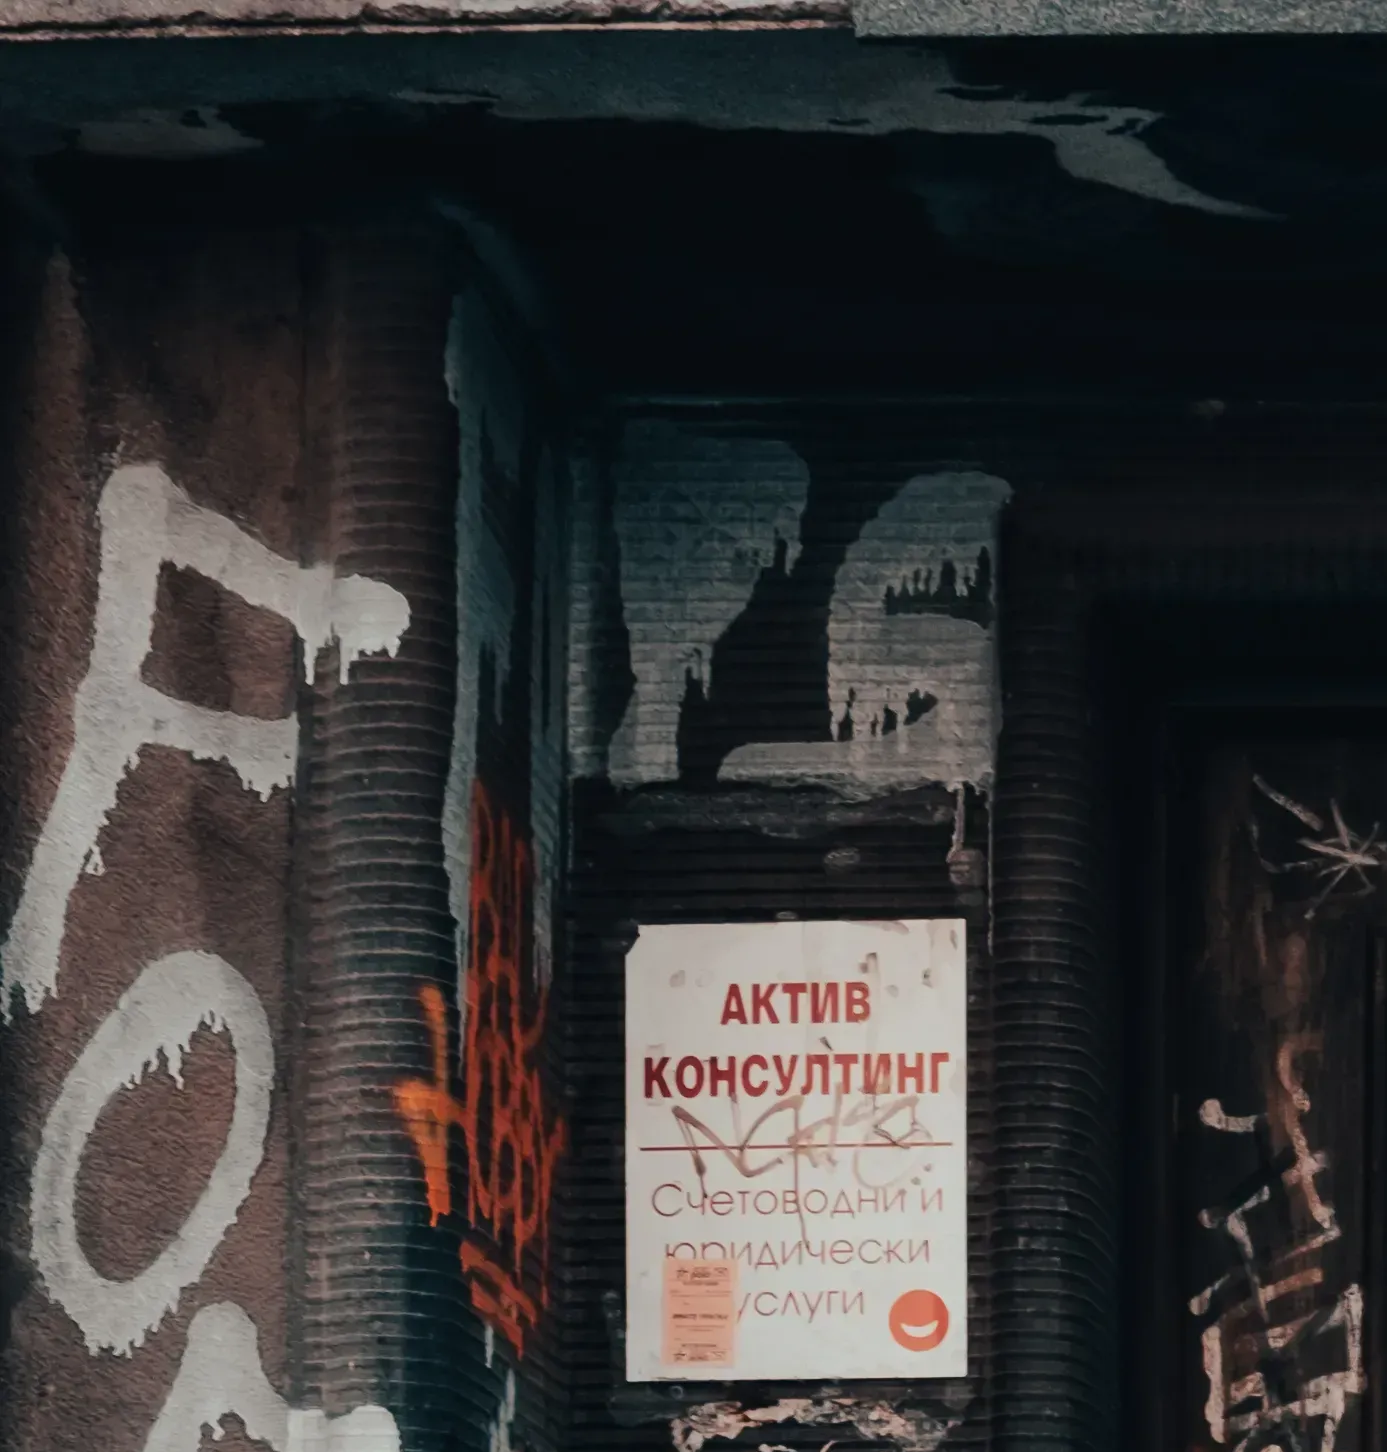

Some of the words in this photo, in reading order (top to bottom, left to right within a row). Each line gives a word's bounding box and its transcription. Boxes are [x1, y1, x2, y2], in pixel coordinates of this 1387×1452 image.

[720, 981, 871, 1025] АКТИВ
[643, 1052, 950, 1099] КОНСУЛТИНГ
[651, 1182, 908, 1220] Счетоводни
[919, 1187, 943, 1213] и
